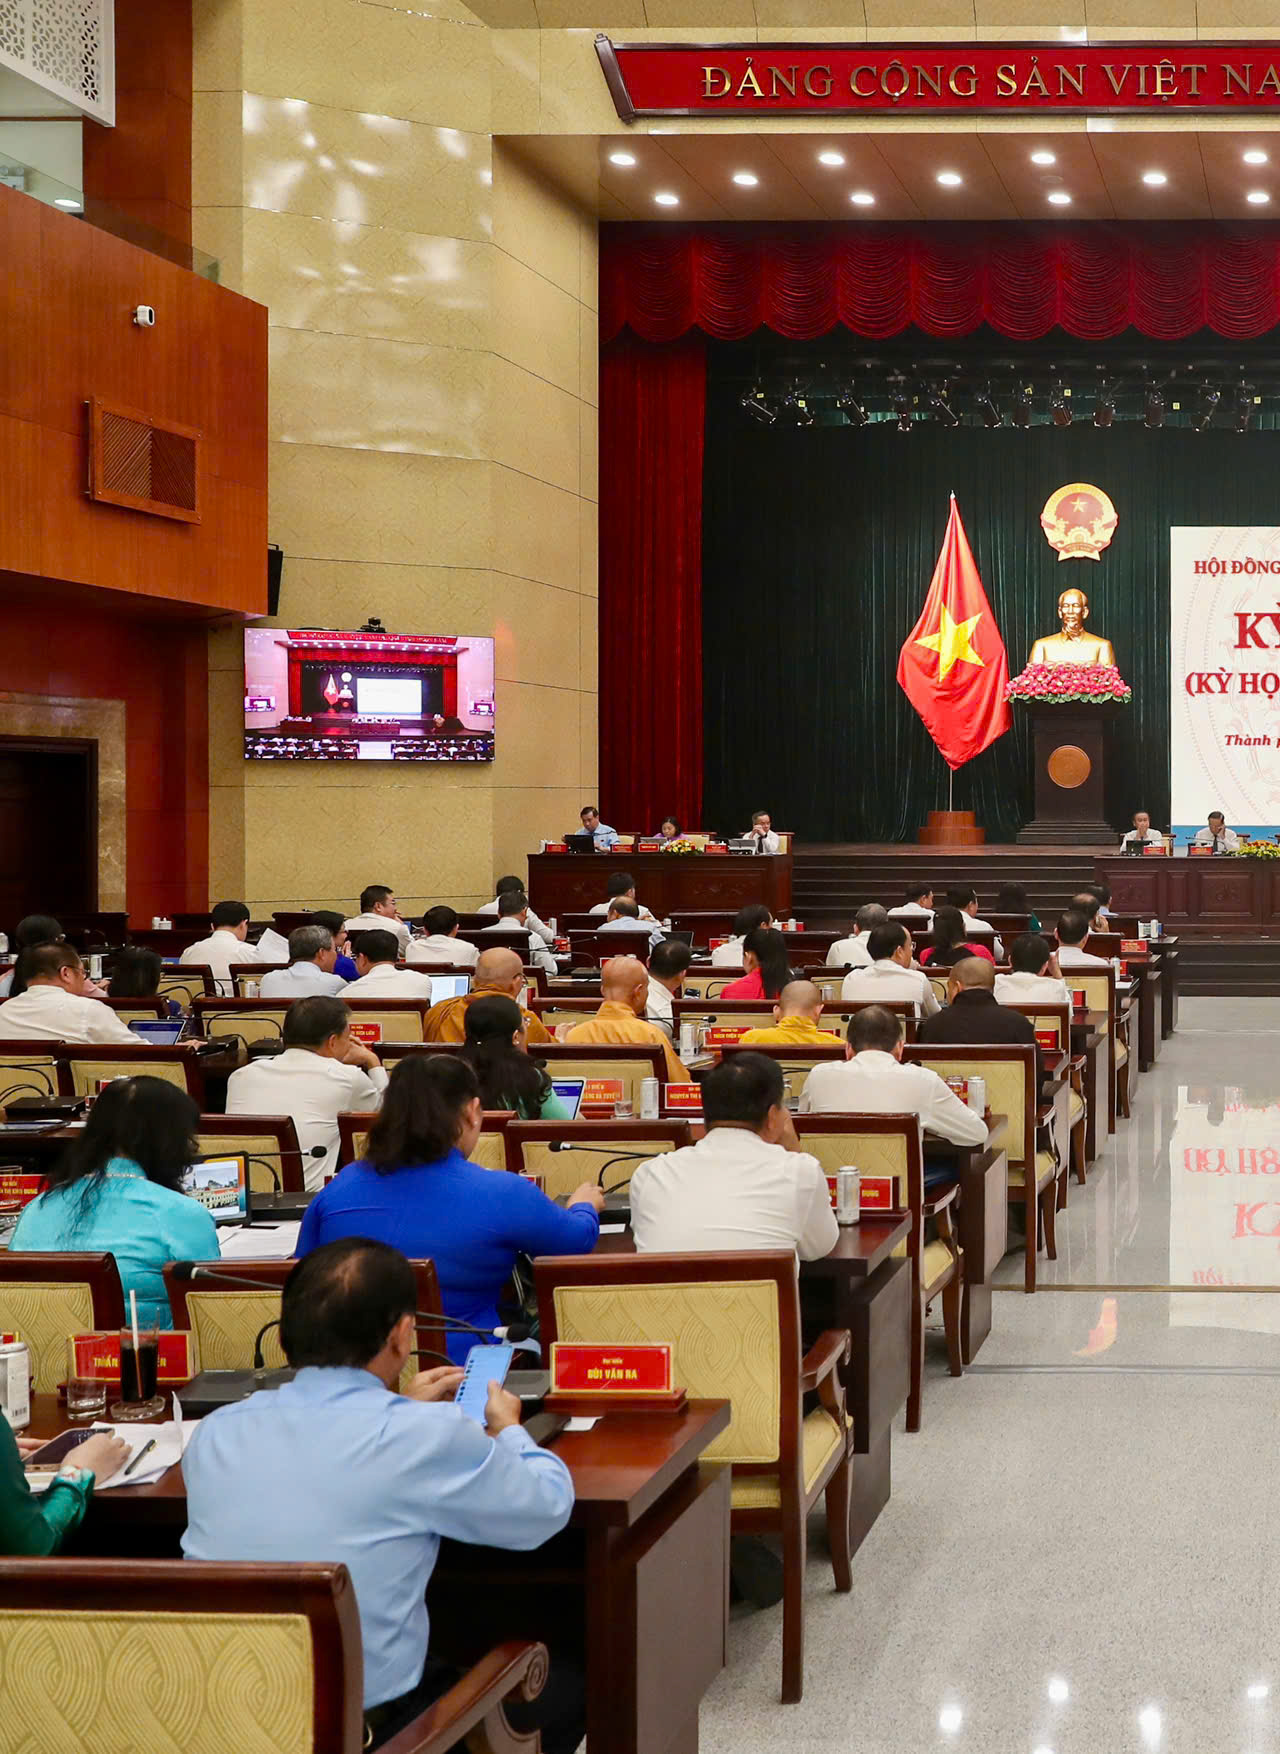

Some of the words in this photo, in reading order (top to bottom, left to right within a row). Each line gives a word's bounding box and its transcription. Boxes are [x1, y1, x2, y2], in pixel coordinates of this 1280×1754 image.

[702, 57, 832, 97] ĐẢNG
[850, 60, 978, 102] CỘNG
[996, 57, 1087, 97] SẢN
[1101, 59, 1207, 102] VIỆT
[1194, 557, 1227, 577] HỘI
[1185, 666, 1233, 698] (KỲ
[1224, 734, 1271, 748] Thành
